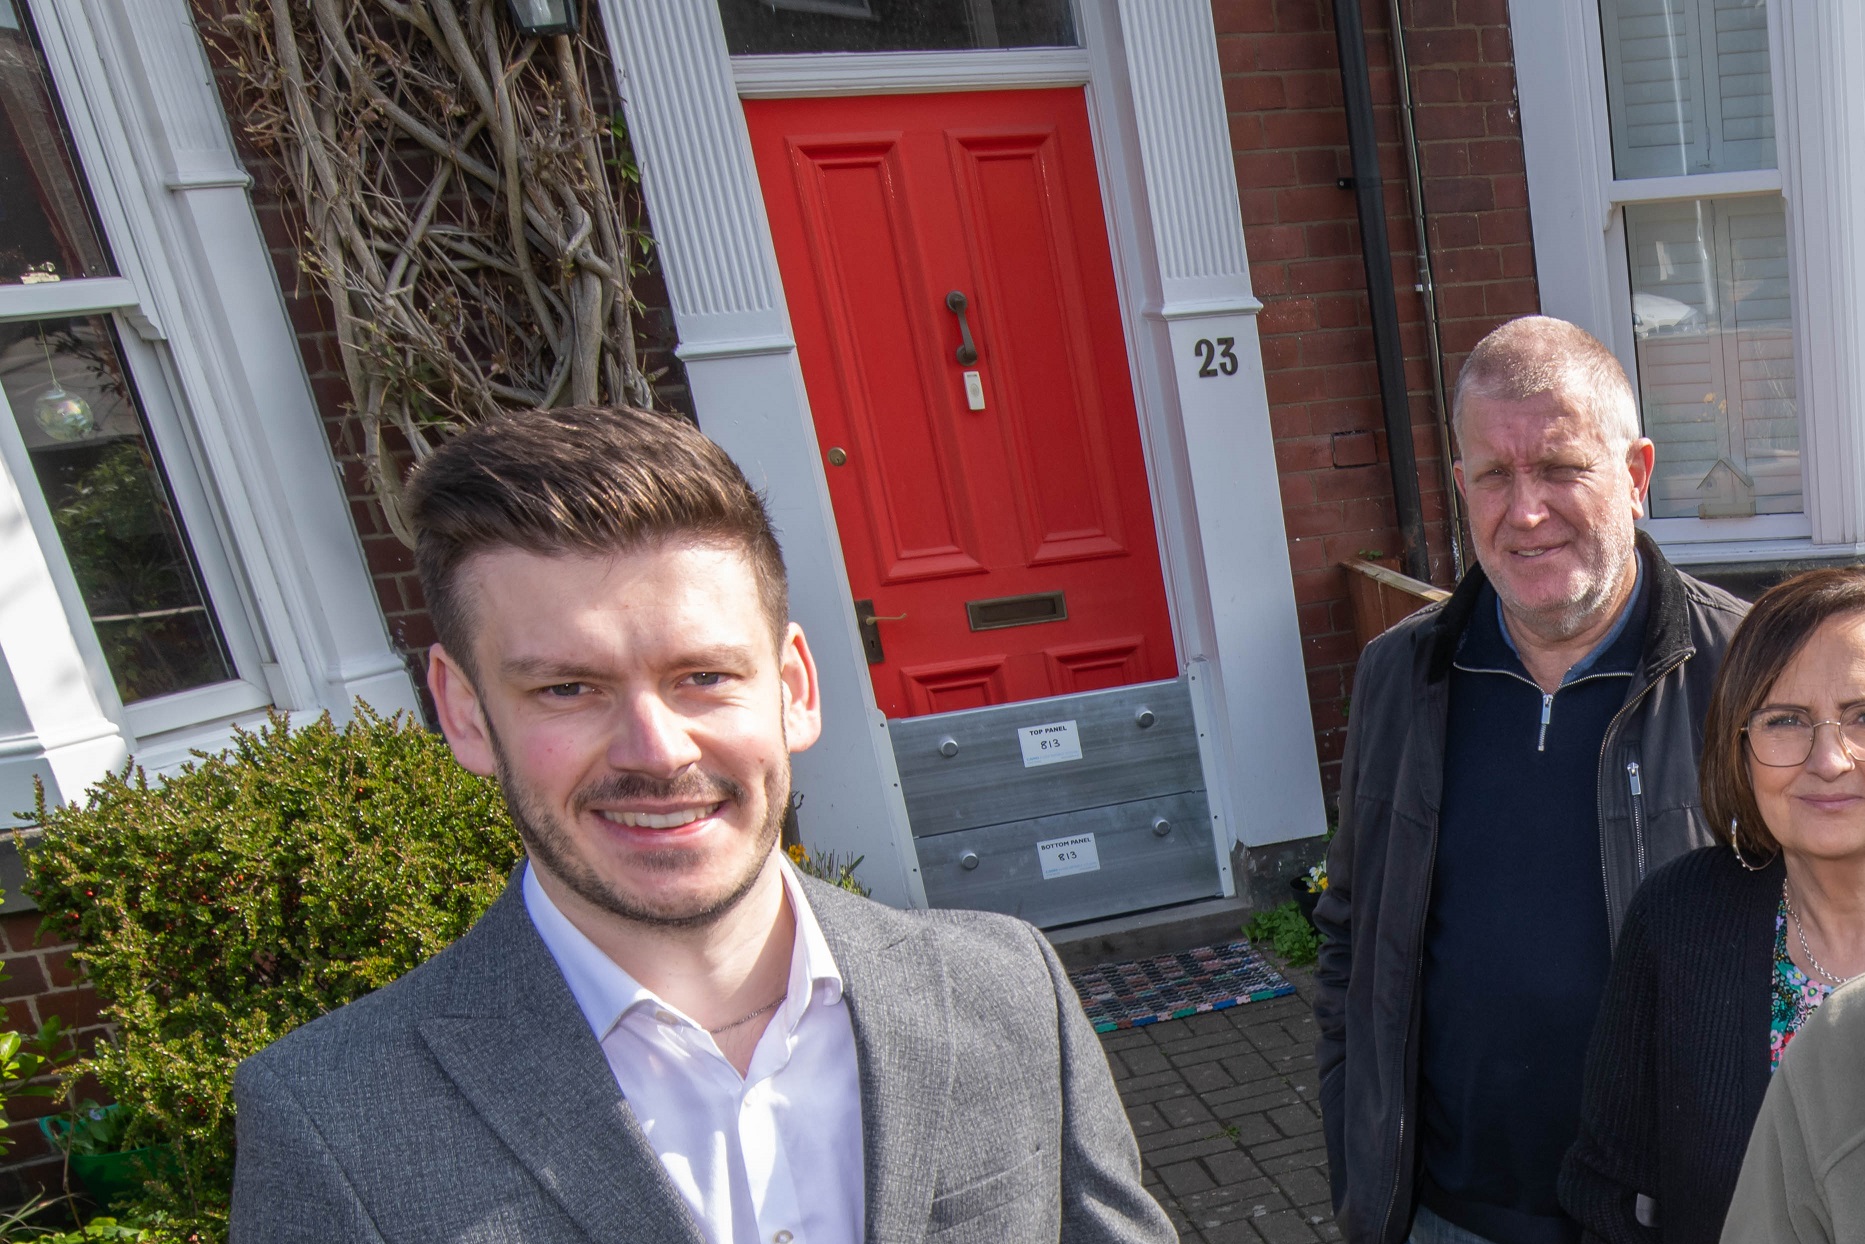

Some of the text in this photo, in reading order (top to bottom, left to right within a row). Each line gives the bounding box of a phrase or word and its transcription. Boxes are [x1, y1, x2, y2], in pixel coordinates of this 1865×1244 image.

[1194, 337, 1239, 378] 23
[1029, 725, 1067, 736] TOP PANEL
[1040, 739, 1061, 750] 813
[1041, 837, 1091, 851] BOTTOM PANEL
